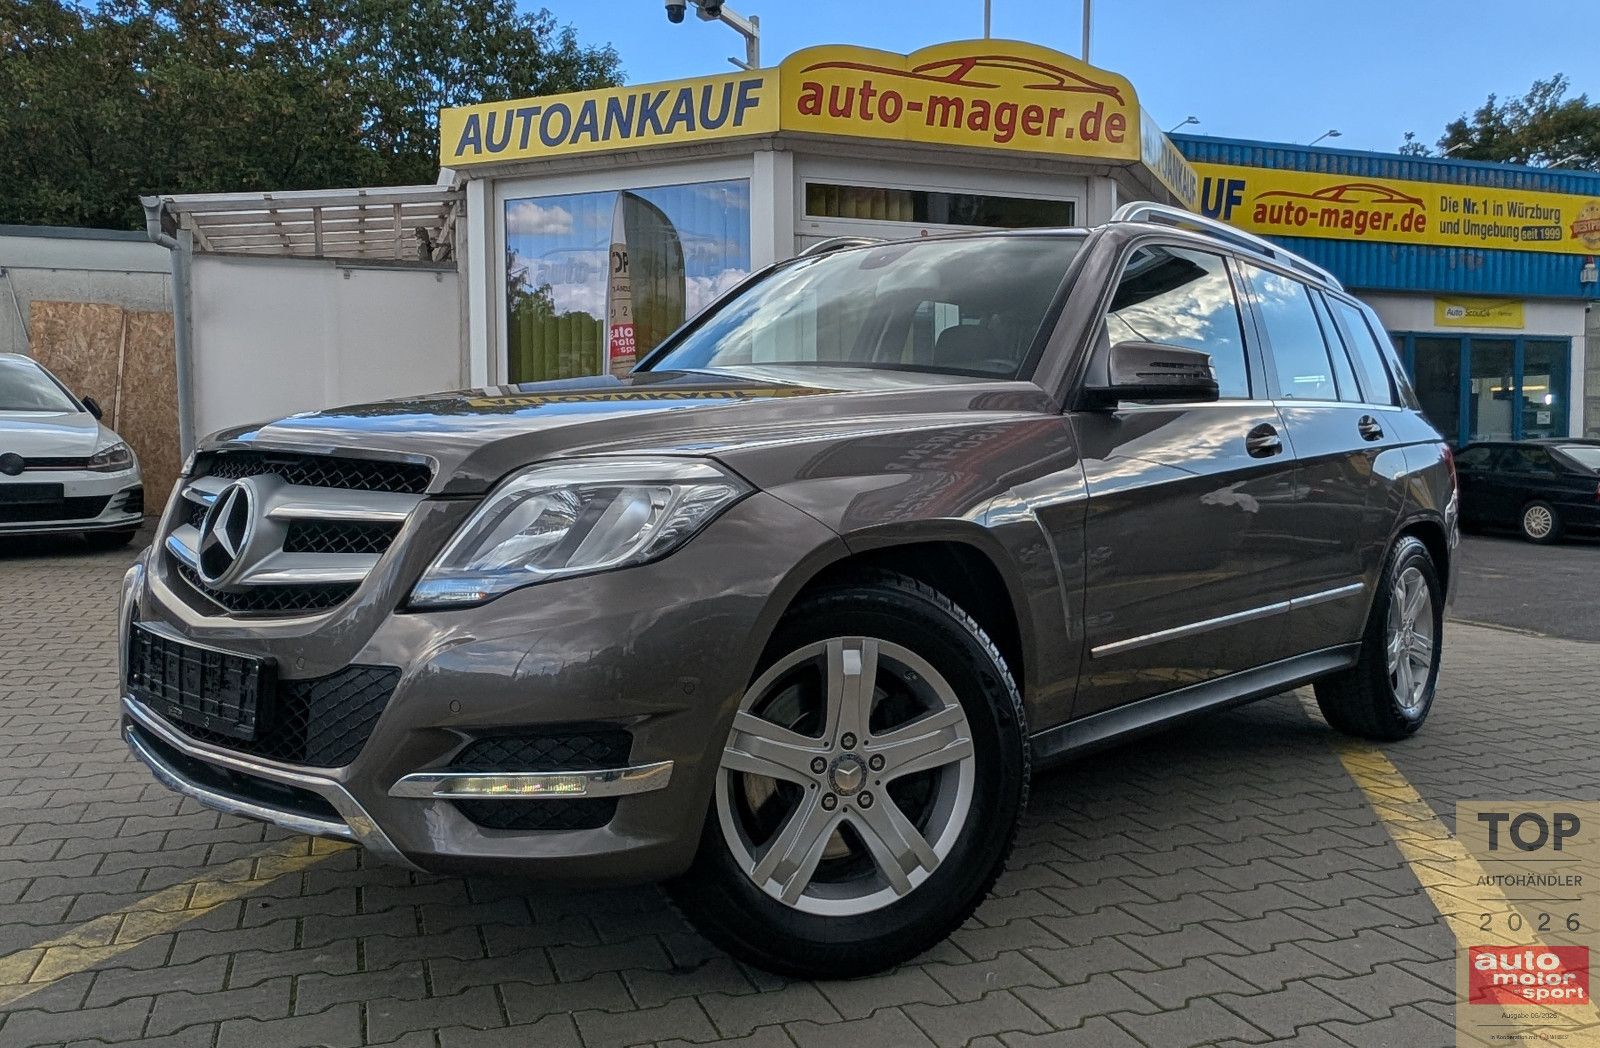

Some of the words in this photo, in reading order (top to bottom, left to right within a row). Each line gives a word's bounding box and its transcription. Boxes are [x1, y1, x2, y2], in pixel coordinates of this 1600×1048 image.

[454, 78, 764, 157] AUTOANKAUF
[797, 79, 1127, 144] auto-mager.de
[1200, 177, 1246, 220] UF
[1440, 195, 1459, 213] Die
[1493, 200, 1503, 216] in
[1507, 201, 1561, 225] Würzburg
[1252, 201, 1427, 236] auto-mager.de
[1440, 218, 1459, 234] und
[1463, 219, 1520, 242] Umgebung
[1522, 227, 1538, 239] seit
[1540, 228, 1561, 240] 1999
[611, 338, 635, 346] oto
